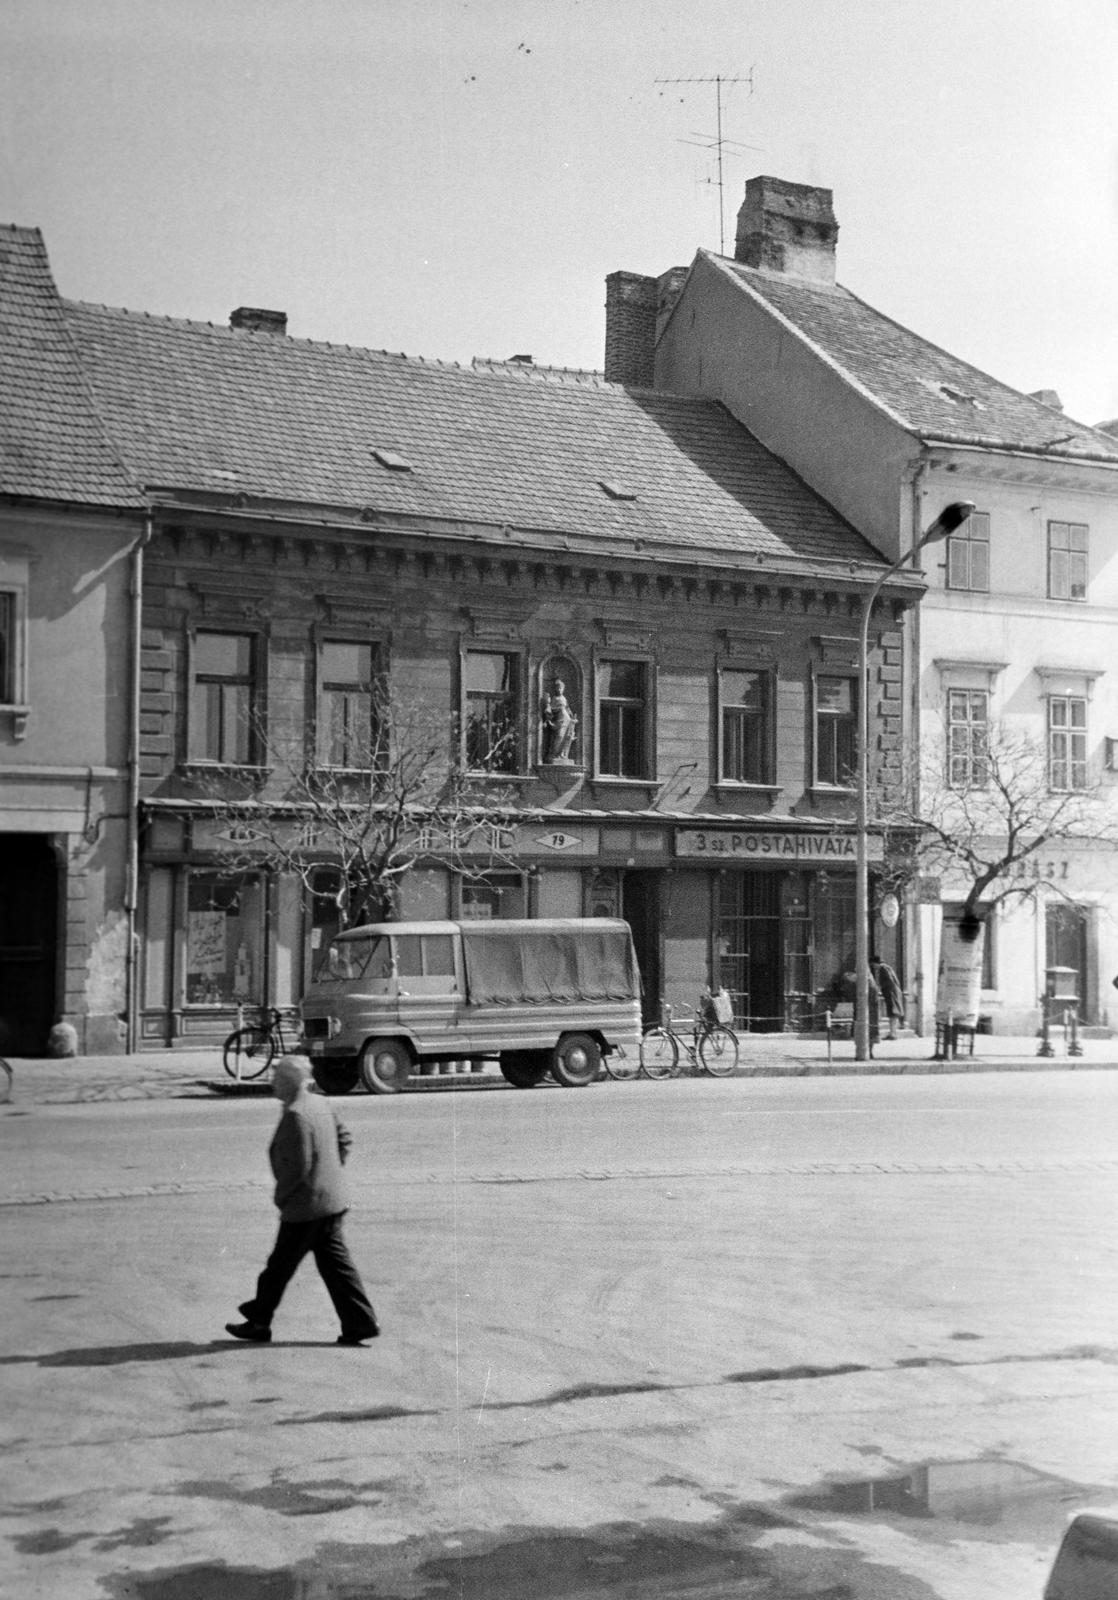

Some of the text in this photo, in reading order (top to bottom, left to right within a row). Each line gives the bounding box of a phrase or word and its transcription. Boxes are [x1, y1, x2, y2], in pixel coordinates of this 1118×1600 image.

[553, 834, 565, 846] 79
[697, 833, 706, 851] 3
[732, 834, 857, 855] POSTAHIVATA
